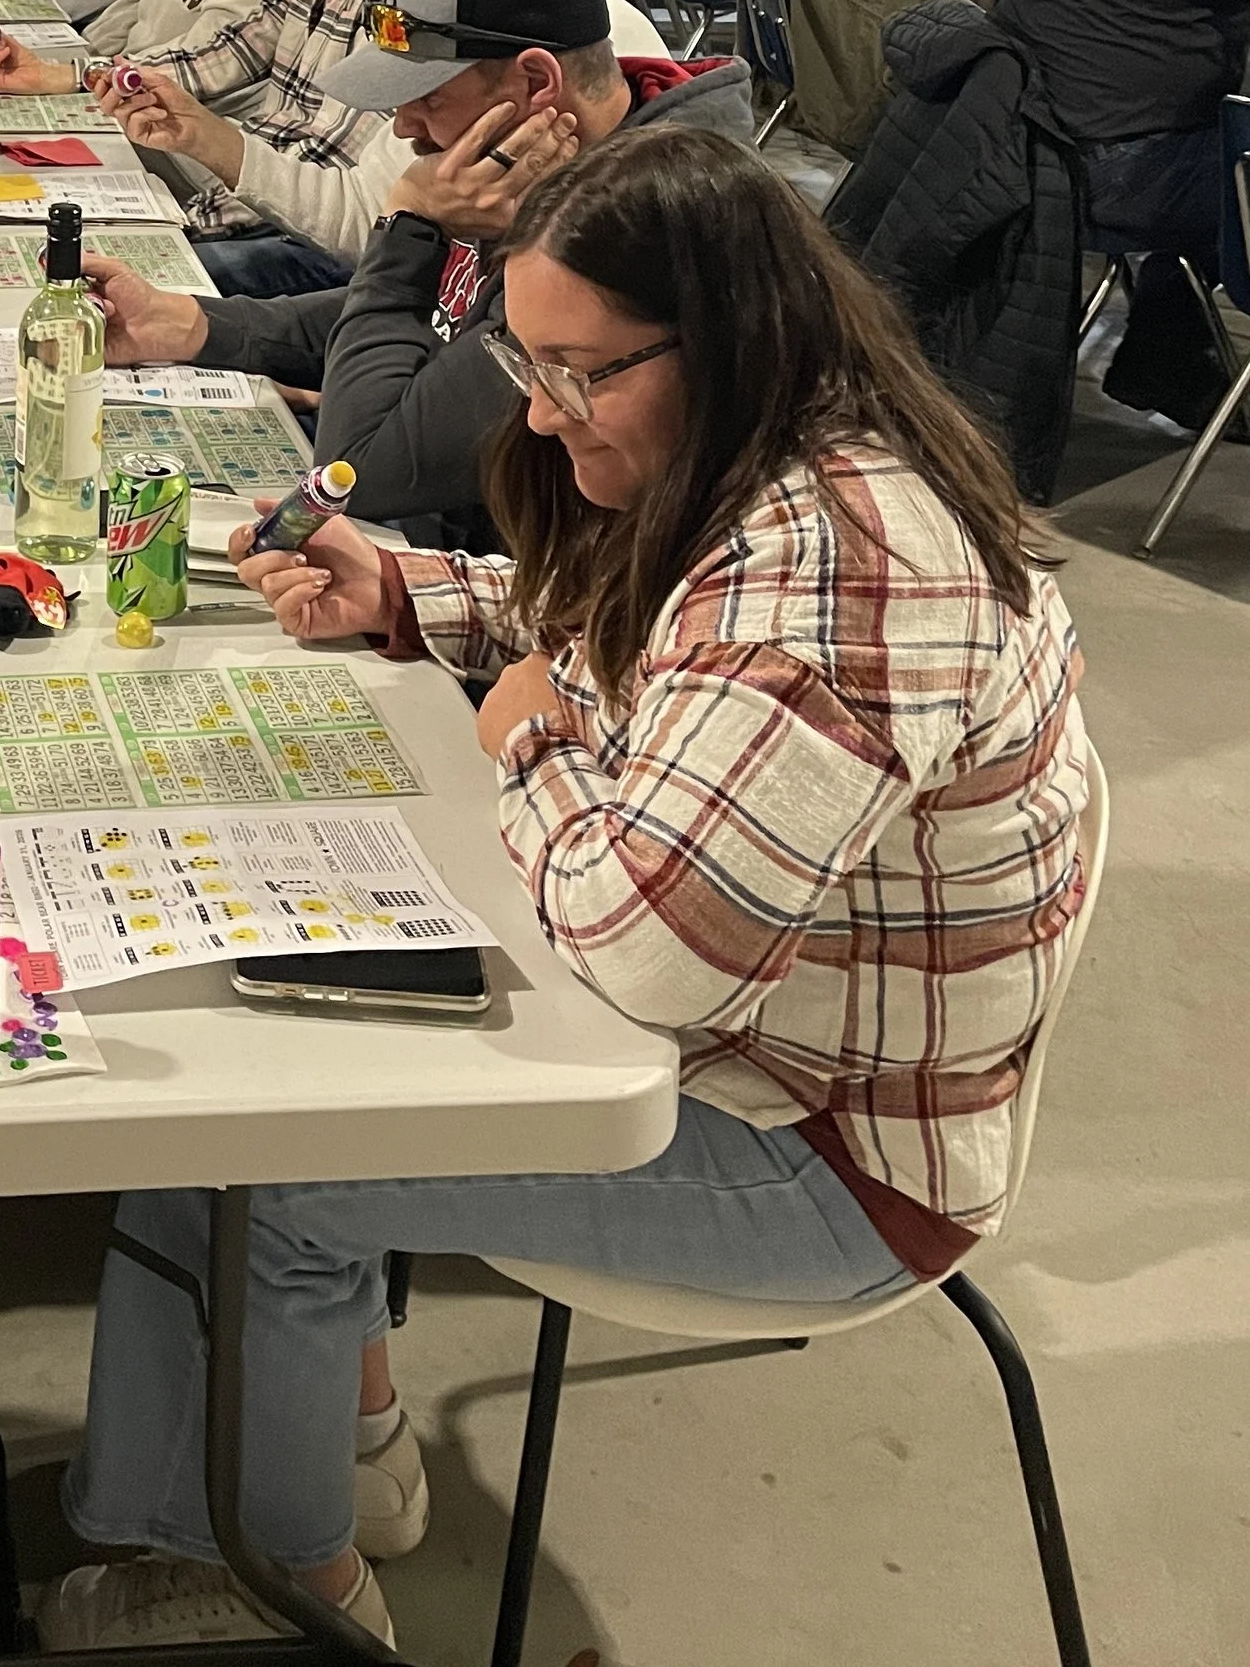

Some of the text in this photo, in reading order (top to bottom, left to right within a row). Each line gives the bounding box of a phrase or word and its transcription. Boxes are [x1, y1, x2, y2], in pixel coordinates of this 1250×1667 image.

[3, 745, 19, 757] 63
[27, 745, 42, 756] 64
[70, 743, 91, 767] 52 69
[6, 758, 21, 769] 49
[30, 757, 45, 769] 59
[10, 772, 27, 782] 33
[37, 783, 54, 794] 22
[41, 797, 59, 808] 11
[28, 958, 50, 986] TICKET
